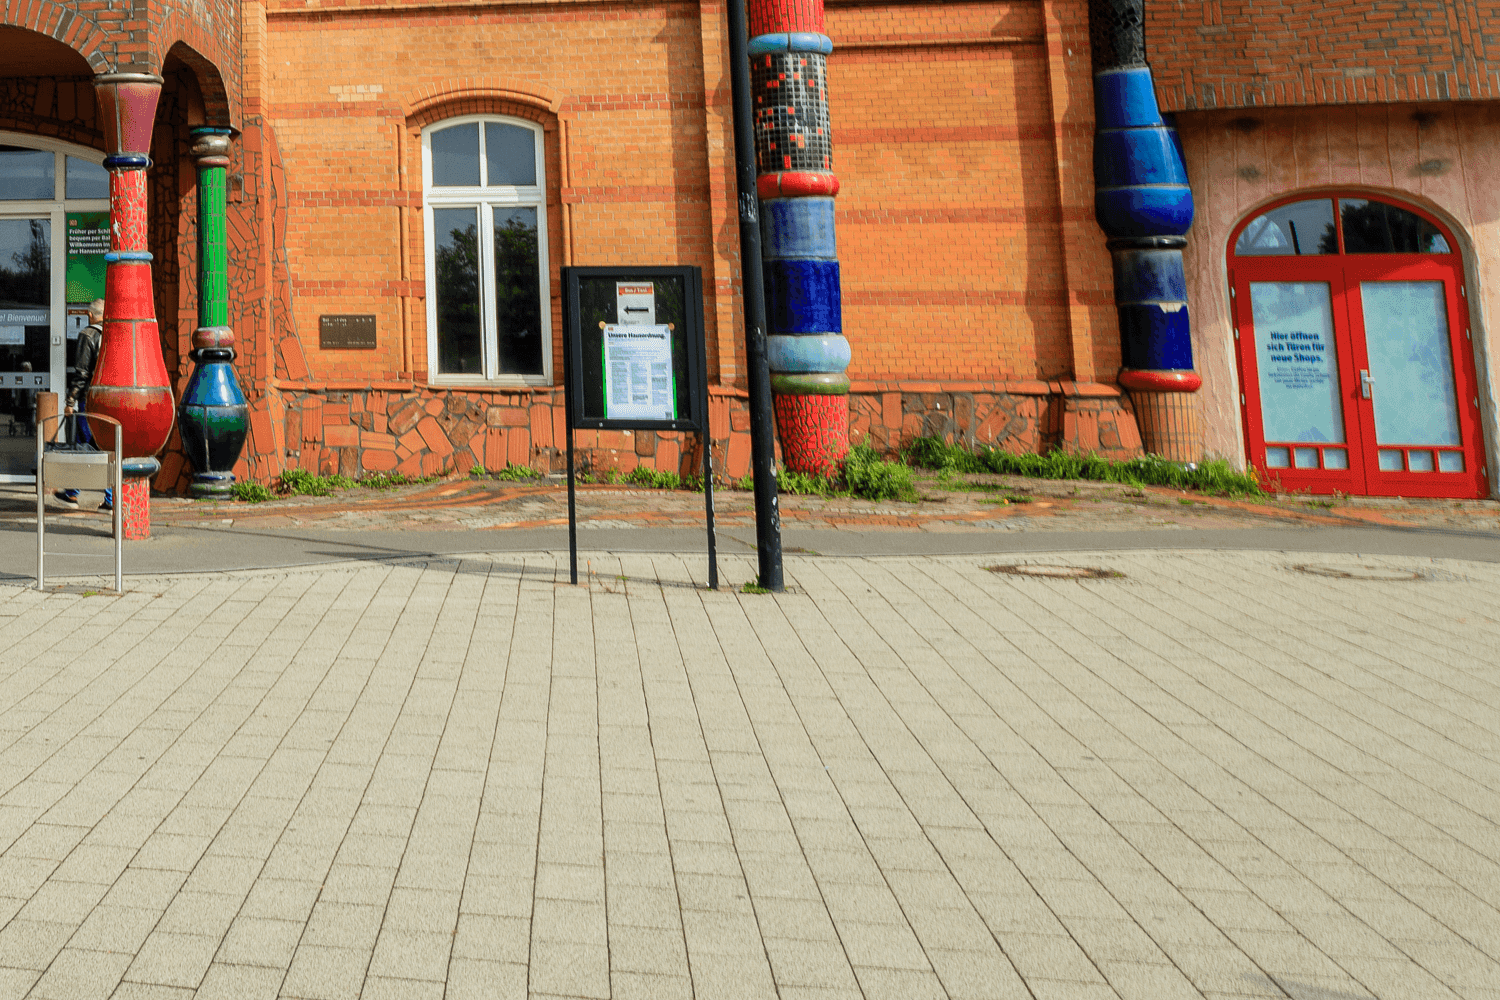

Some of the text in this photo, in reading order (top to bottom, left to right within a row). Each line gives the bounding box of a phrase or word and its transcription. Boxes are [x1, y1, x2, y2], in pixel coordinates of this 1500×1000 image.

[7, 313, 47, 322] Bienvenue!
[1270, 331, 1320, 341] Hier öffnen
[1266, 342, 1325, 351] sich Türen für
[1270, 352, 1324, 365] neue Shops.
